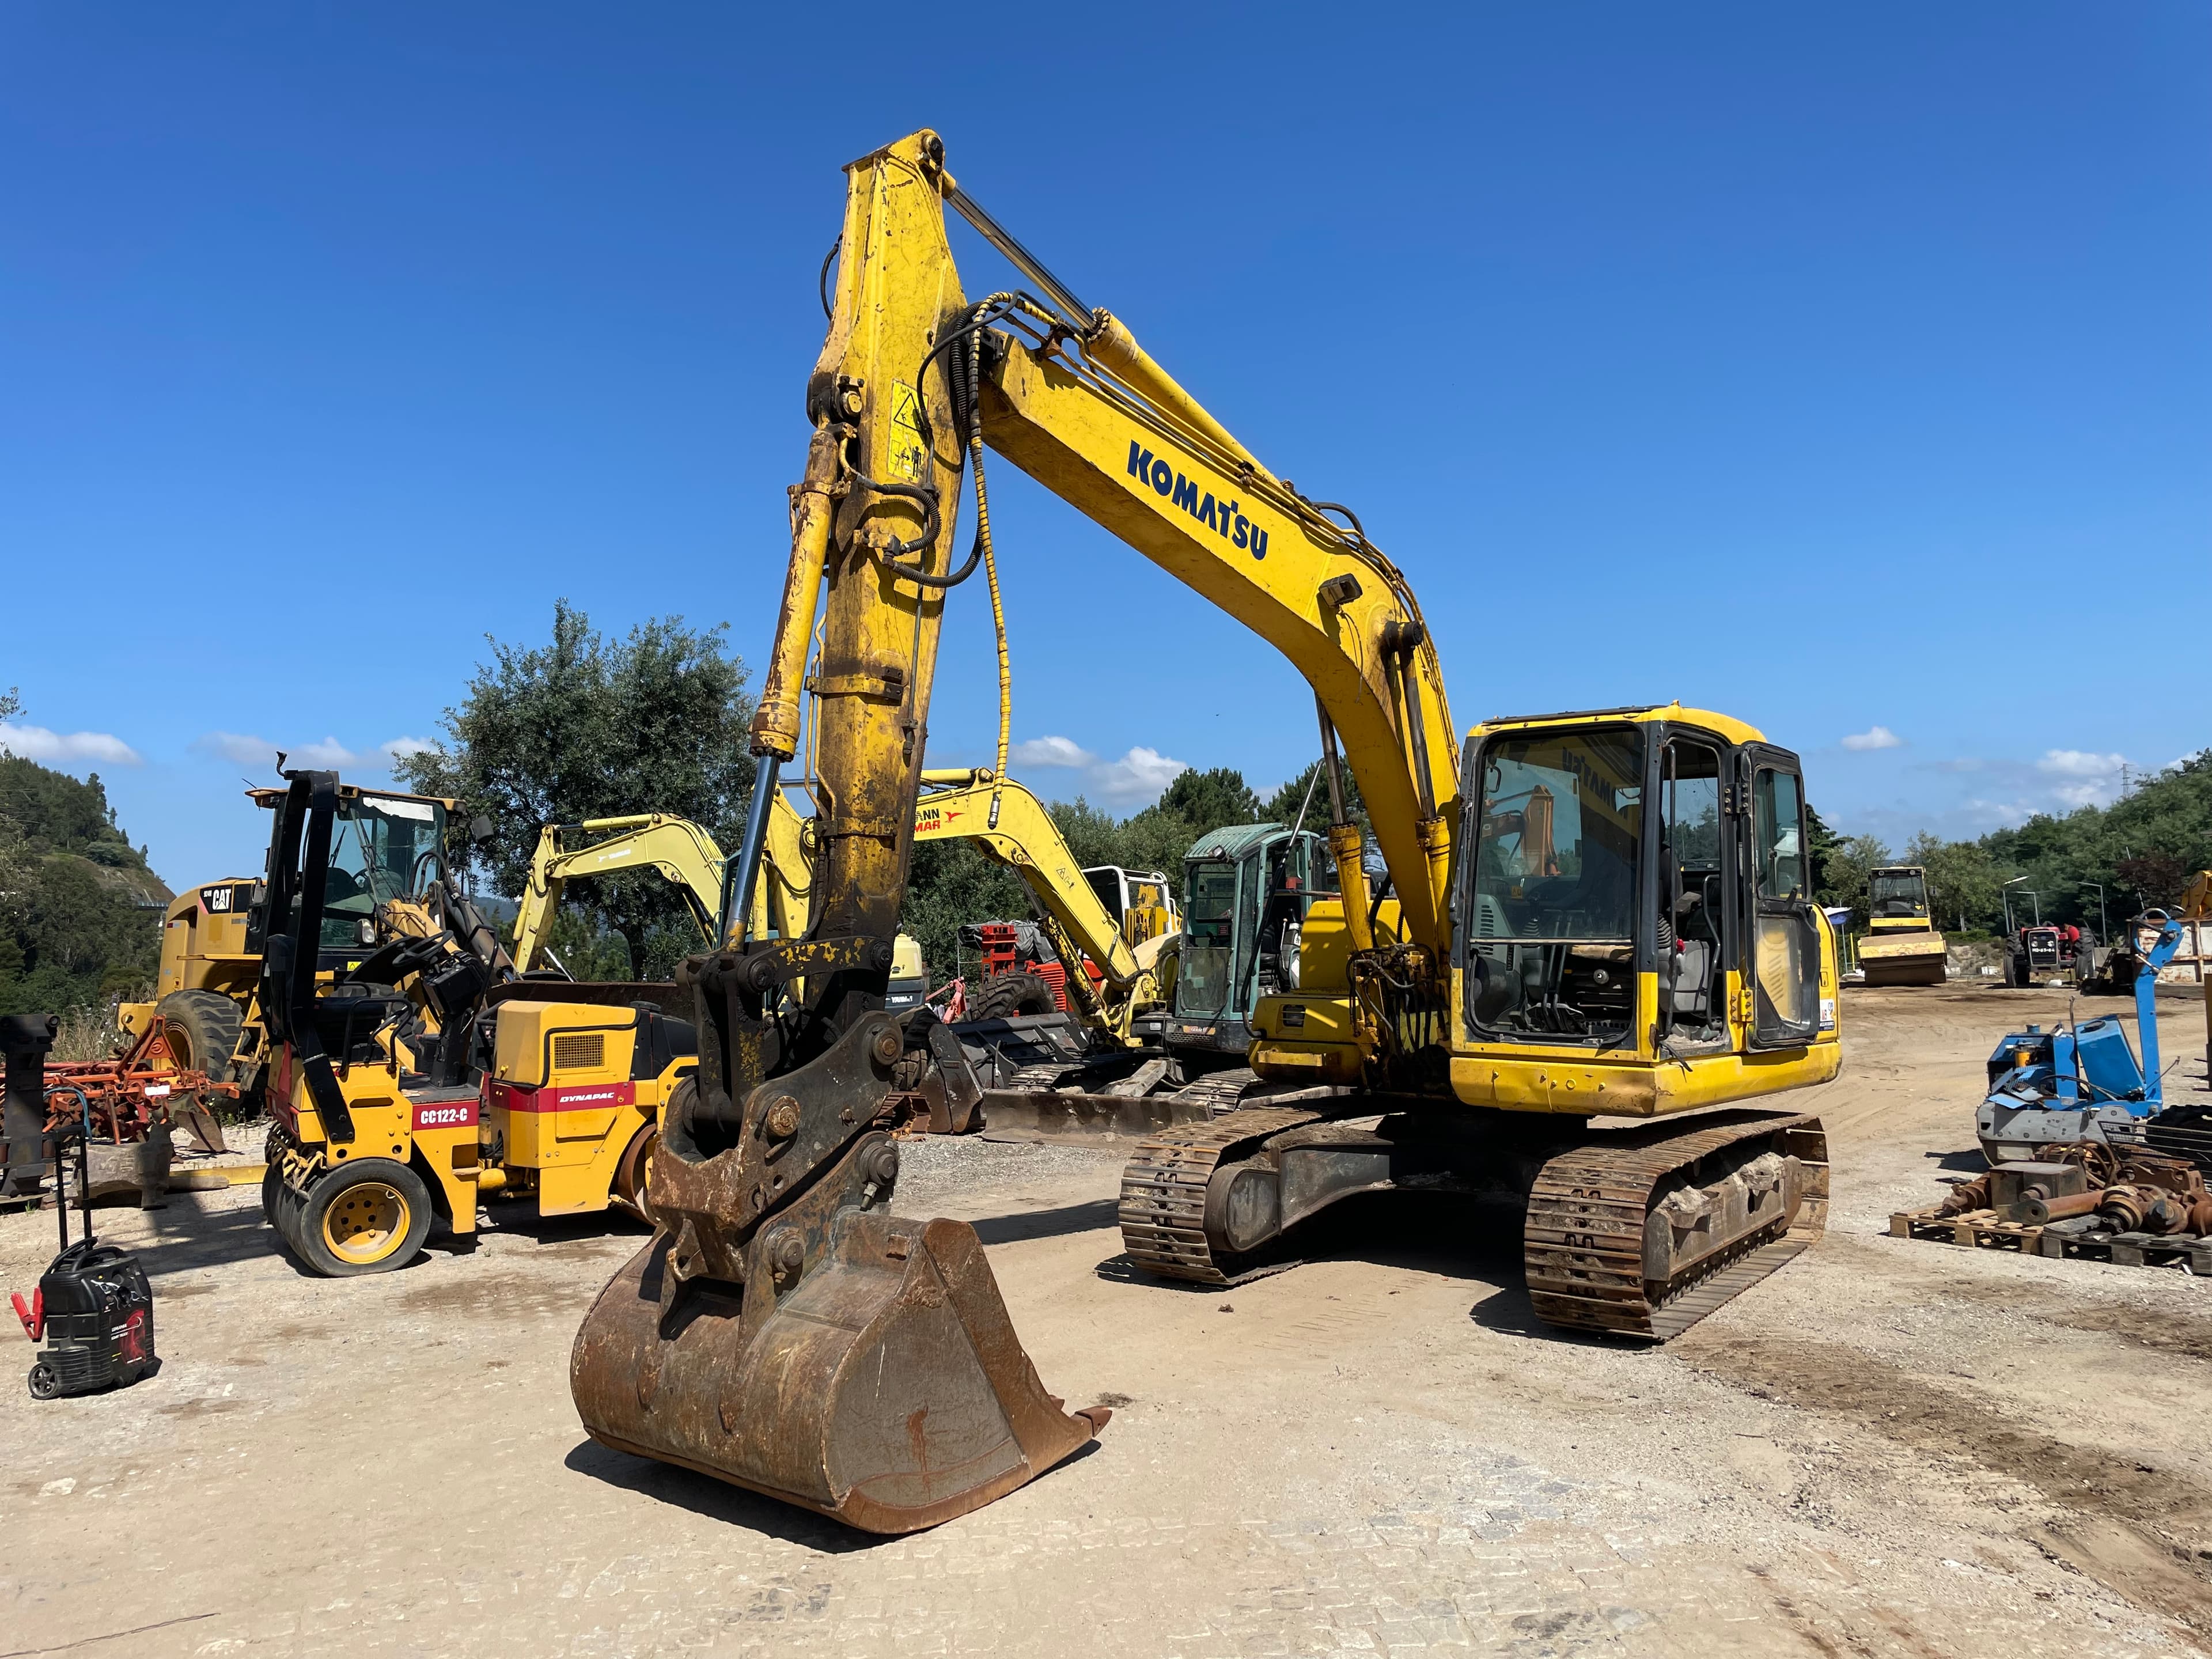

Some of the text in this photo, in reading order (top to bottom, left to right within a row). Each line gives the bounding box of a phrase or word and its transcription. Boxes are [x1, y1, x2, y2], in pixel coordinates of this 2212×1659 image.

[1127, 440, 1268, 560] KOMATSU
[212, 888, 232, 910] CAT
[559, 1092, 615, 1103] DYNAPAC
[421, 1108, 468, 1124] CC122-C
